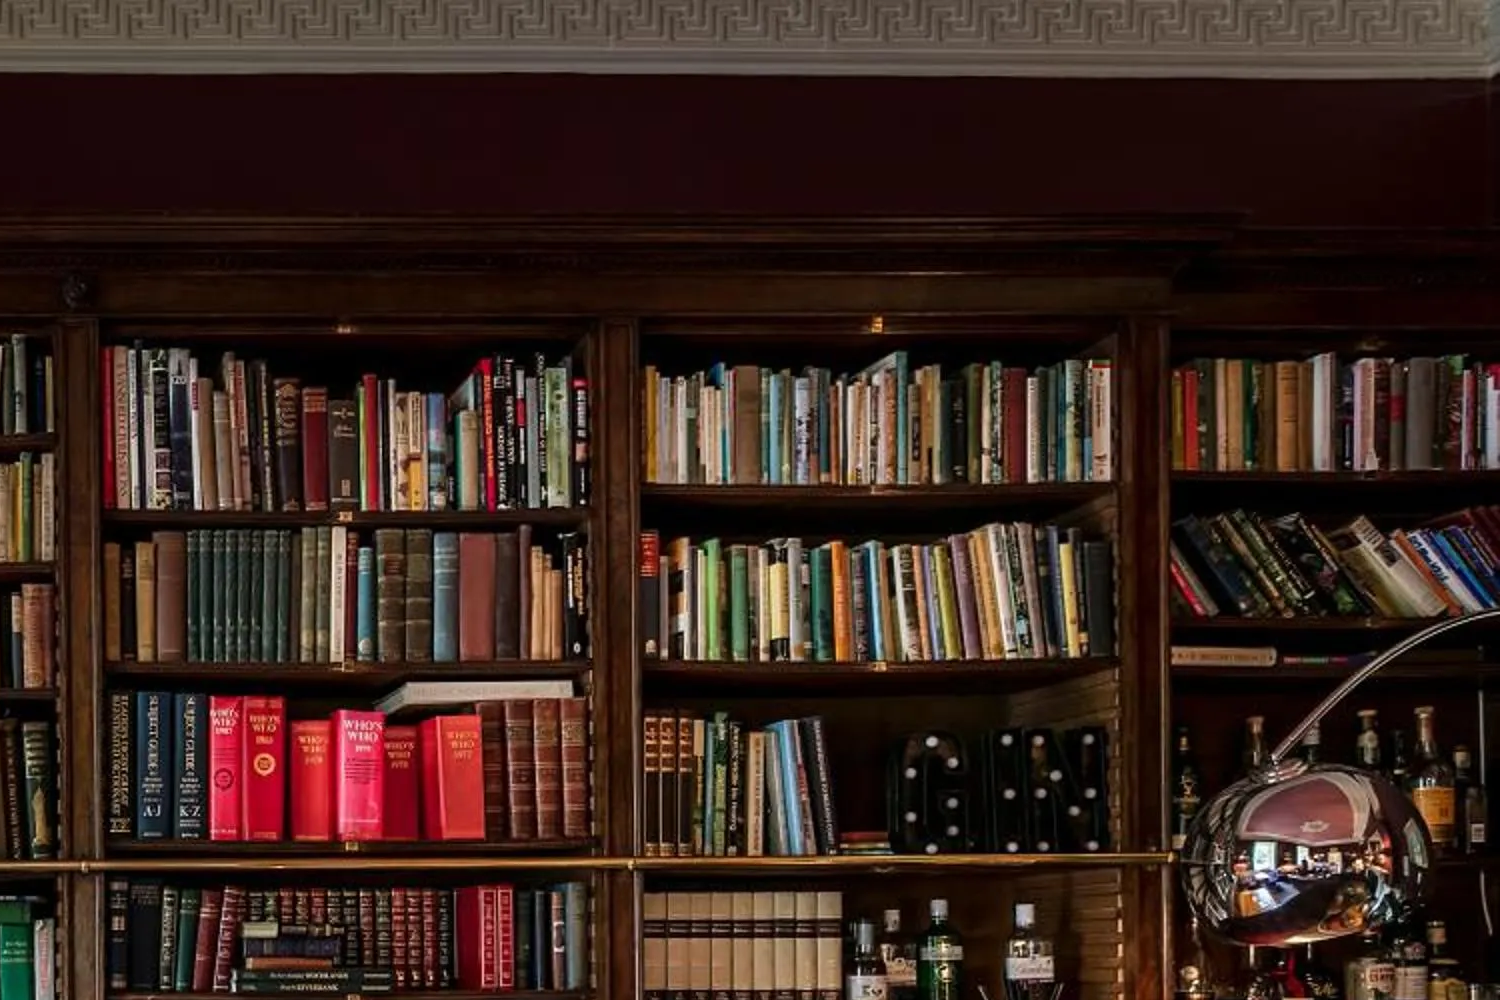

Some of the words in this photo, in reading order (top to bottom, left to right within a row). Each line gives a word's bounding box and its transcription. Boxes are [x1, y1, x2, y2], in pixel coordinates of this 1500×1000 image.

[343, 719, 383, 731] WHO'S
[347, 731, 379, 742] WHO
[184, 740, 196, 771] GUIDE
